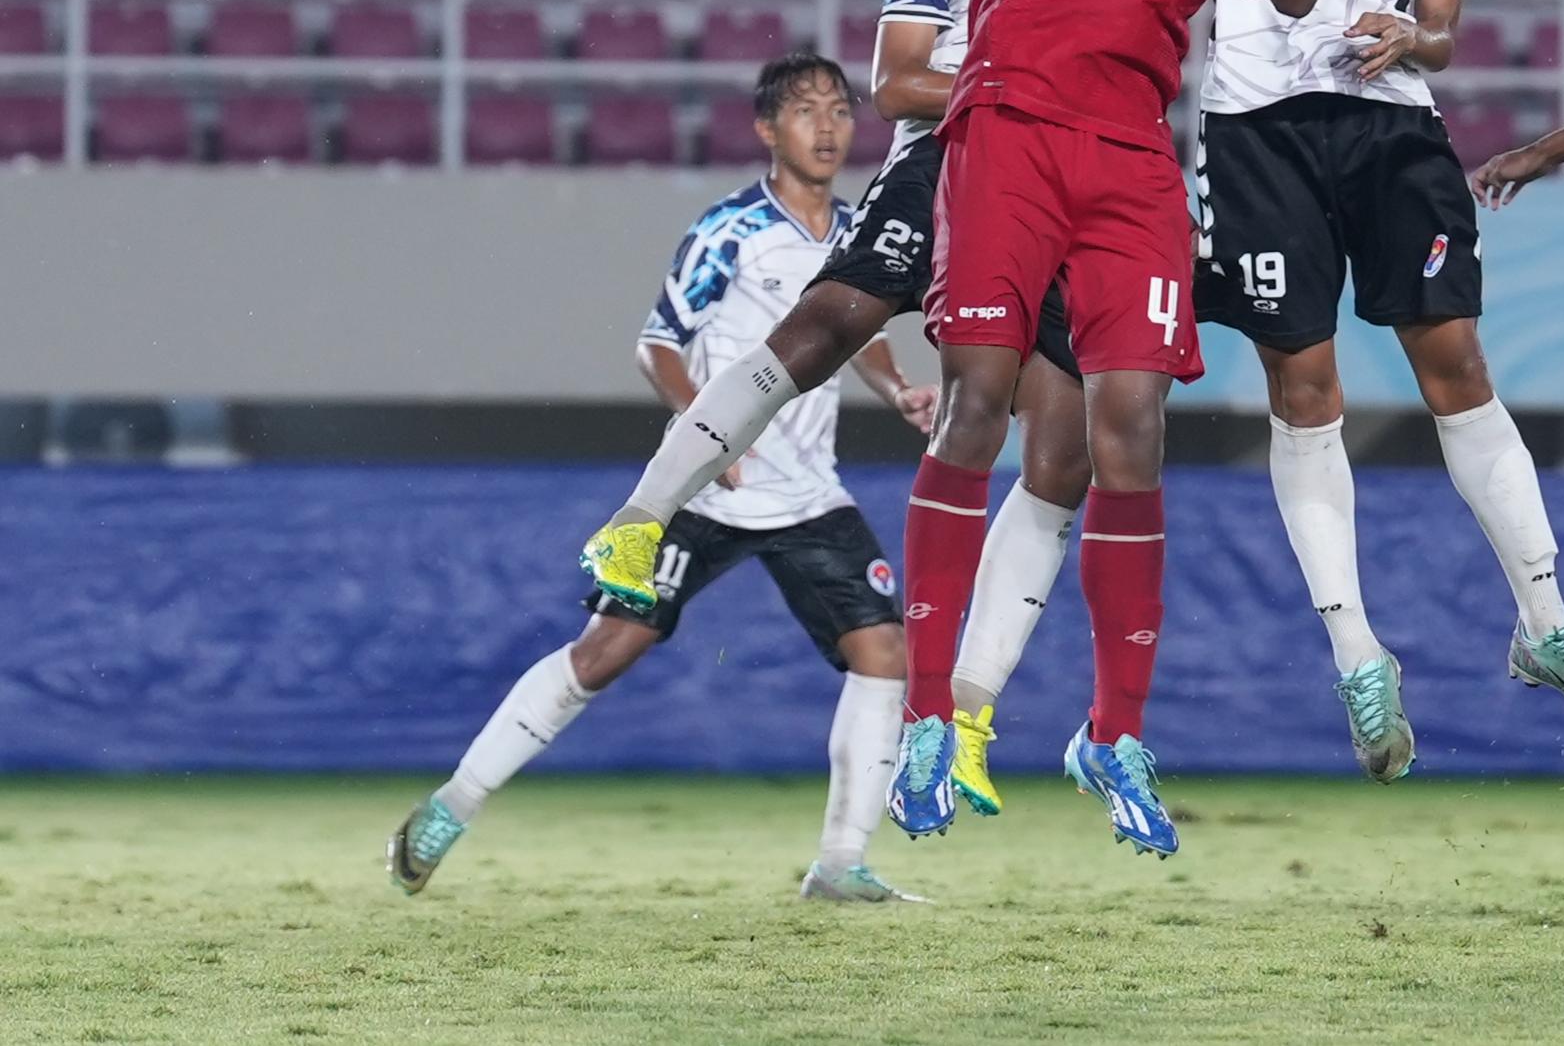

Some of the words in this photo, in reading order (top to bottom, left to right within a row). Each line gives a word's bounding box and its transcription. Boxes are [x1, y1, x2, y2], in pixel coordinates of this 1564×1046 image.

[1238, 251, 1287, 298] 19
[959, 306, 1006, 320] erspo
[1147, 276, 1179, 346] 4
[655, 544, 691, 589] 11
